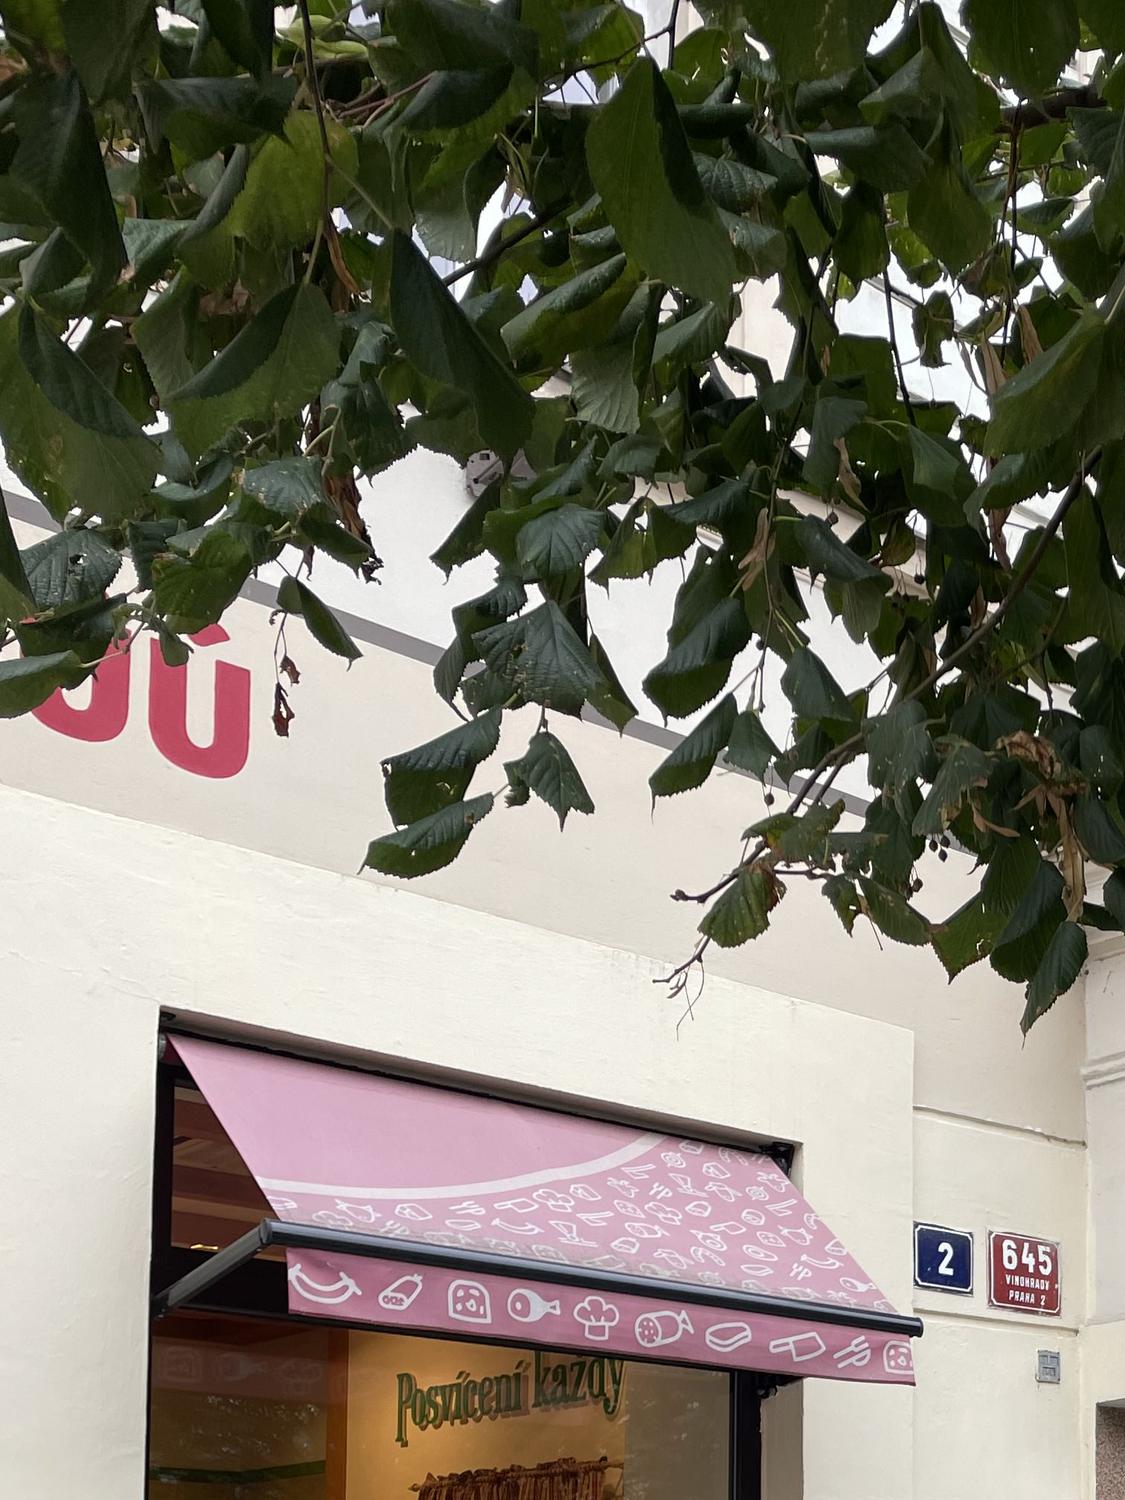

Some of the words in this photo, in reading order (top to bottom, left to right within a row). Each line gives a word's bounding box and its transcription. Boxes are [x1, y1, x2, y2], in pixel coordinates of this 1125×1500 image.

[937, 1241, 954, 1276] 2
[1002, 1239, 1052, 1276] 645
[1005, 1274, 1050, 1291] VINOHRADY
[1008, 1290, 1035, 1304] PRAHA
[1040, 1294, 1046, 1306] 2
